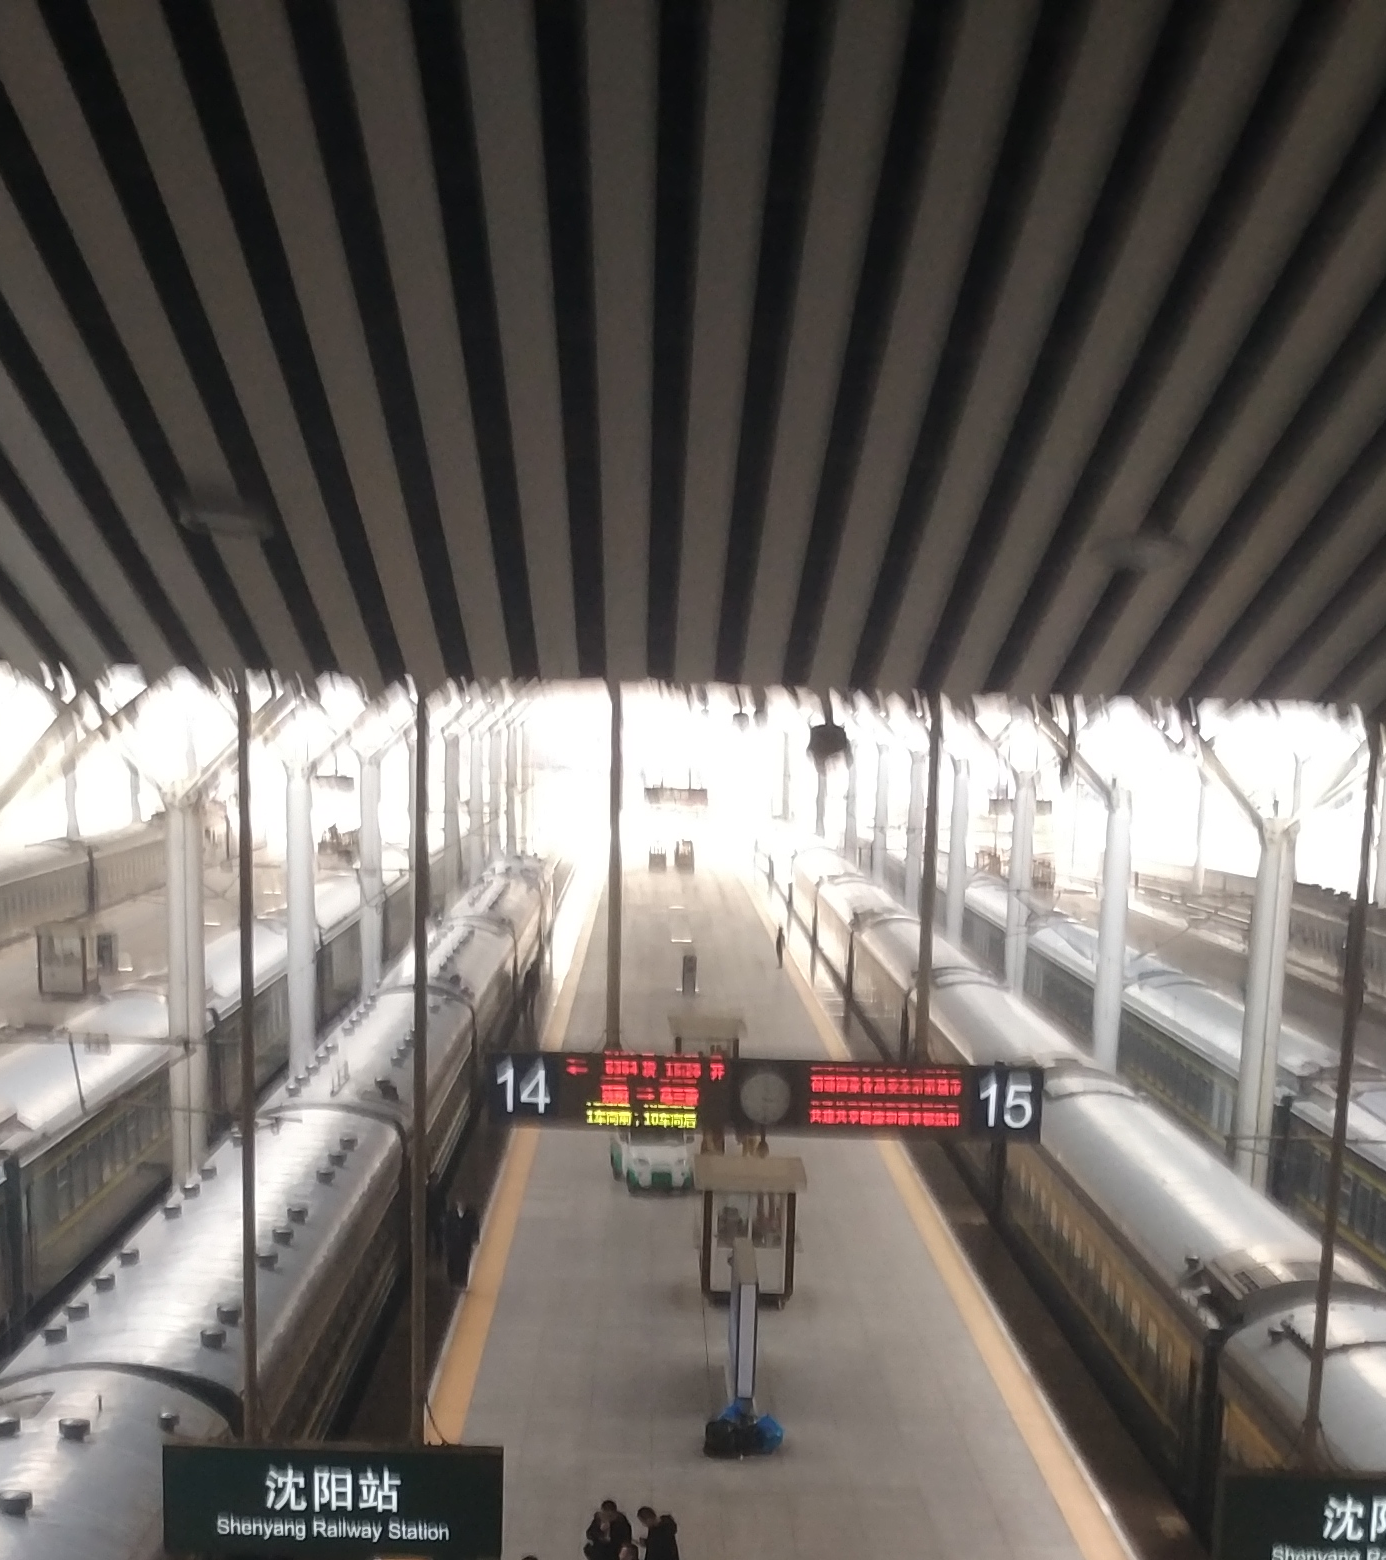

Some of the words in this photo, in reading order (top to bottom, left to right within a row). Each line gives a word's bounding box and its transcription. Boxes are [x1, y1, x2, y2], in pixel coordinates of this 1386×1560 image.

[495, 1056, 552, 1115] 14
[978, 1073, 1034, 1130] 15
[265, 1464, 401, 1513] 沈阳站
[217, 1513, 306, 1541] Shenyang
[313, 1516, 382, 1543] Railway
[388, 1517, 450, 1541] Station
